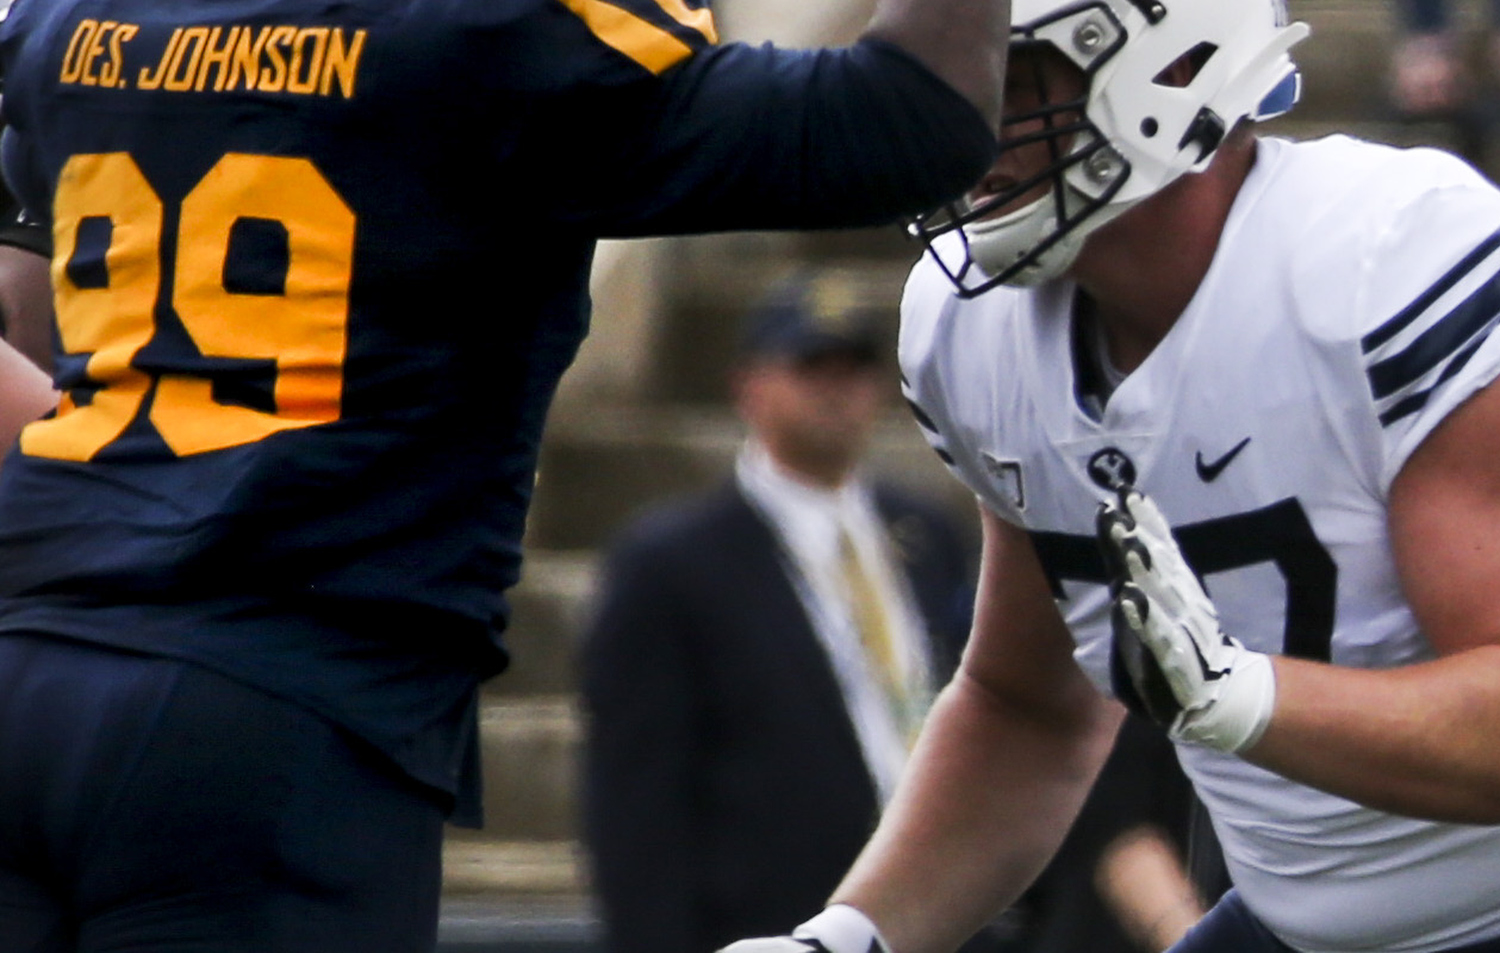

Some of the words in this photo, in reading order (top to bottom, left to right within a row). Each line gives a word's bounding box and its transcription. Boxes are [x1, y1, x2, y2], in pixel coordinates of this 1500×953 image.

[60, 18, 139, 89] DES.
[137, 24, 368, 100] JOHNSON
[20, 150, 357, 463] 99
